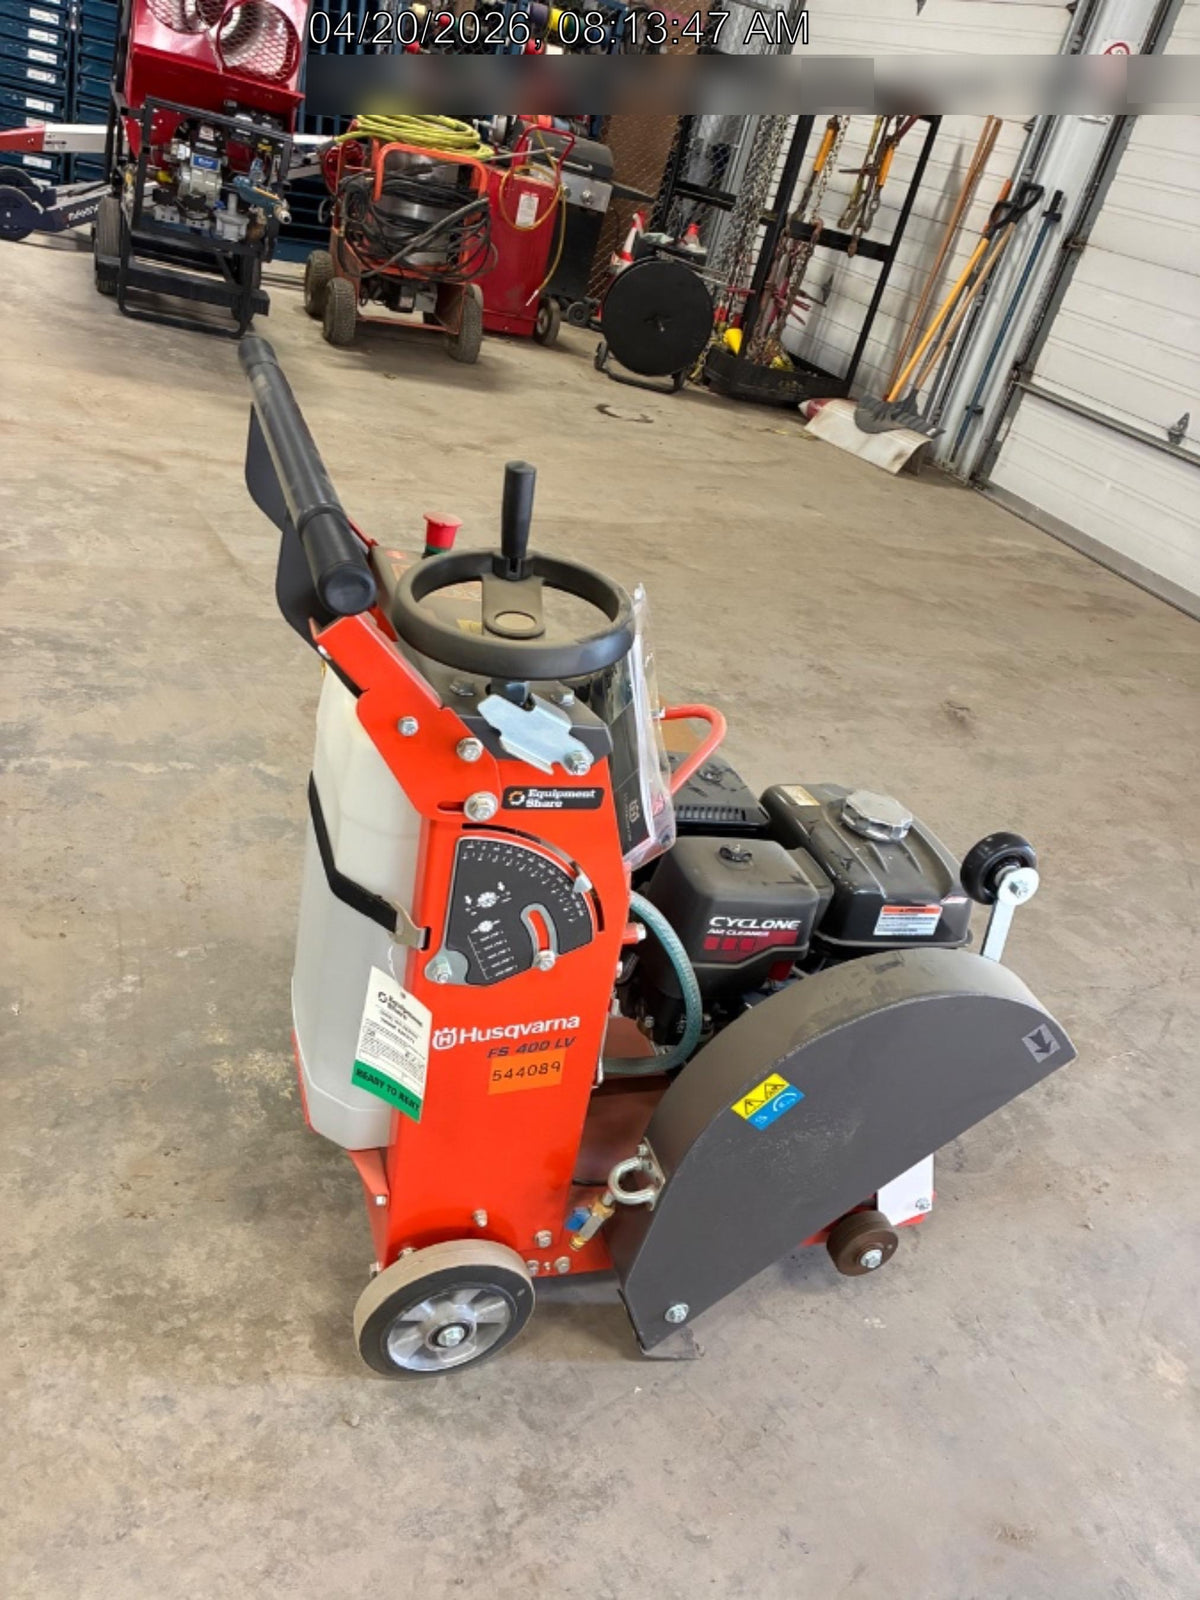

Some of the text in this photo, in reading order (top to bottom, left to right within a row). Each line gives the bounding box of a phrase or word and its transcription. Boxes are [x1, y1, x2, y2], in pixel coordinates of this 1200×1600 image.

[525, 799, 563, 808] Share
[527, 788, 596, 799] Equipment
[709, 916, 802, 930] CYCLONE
[459, 1016, 580, 1044] Husqvarna
[487, 1036, 576, 1059] FS 400 LV
[492, 1061, 561, 1082] 544089
[355, 1068, 420, 1111] READY TO RENT
